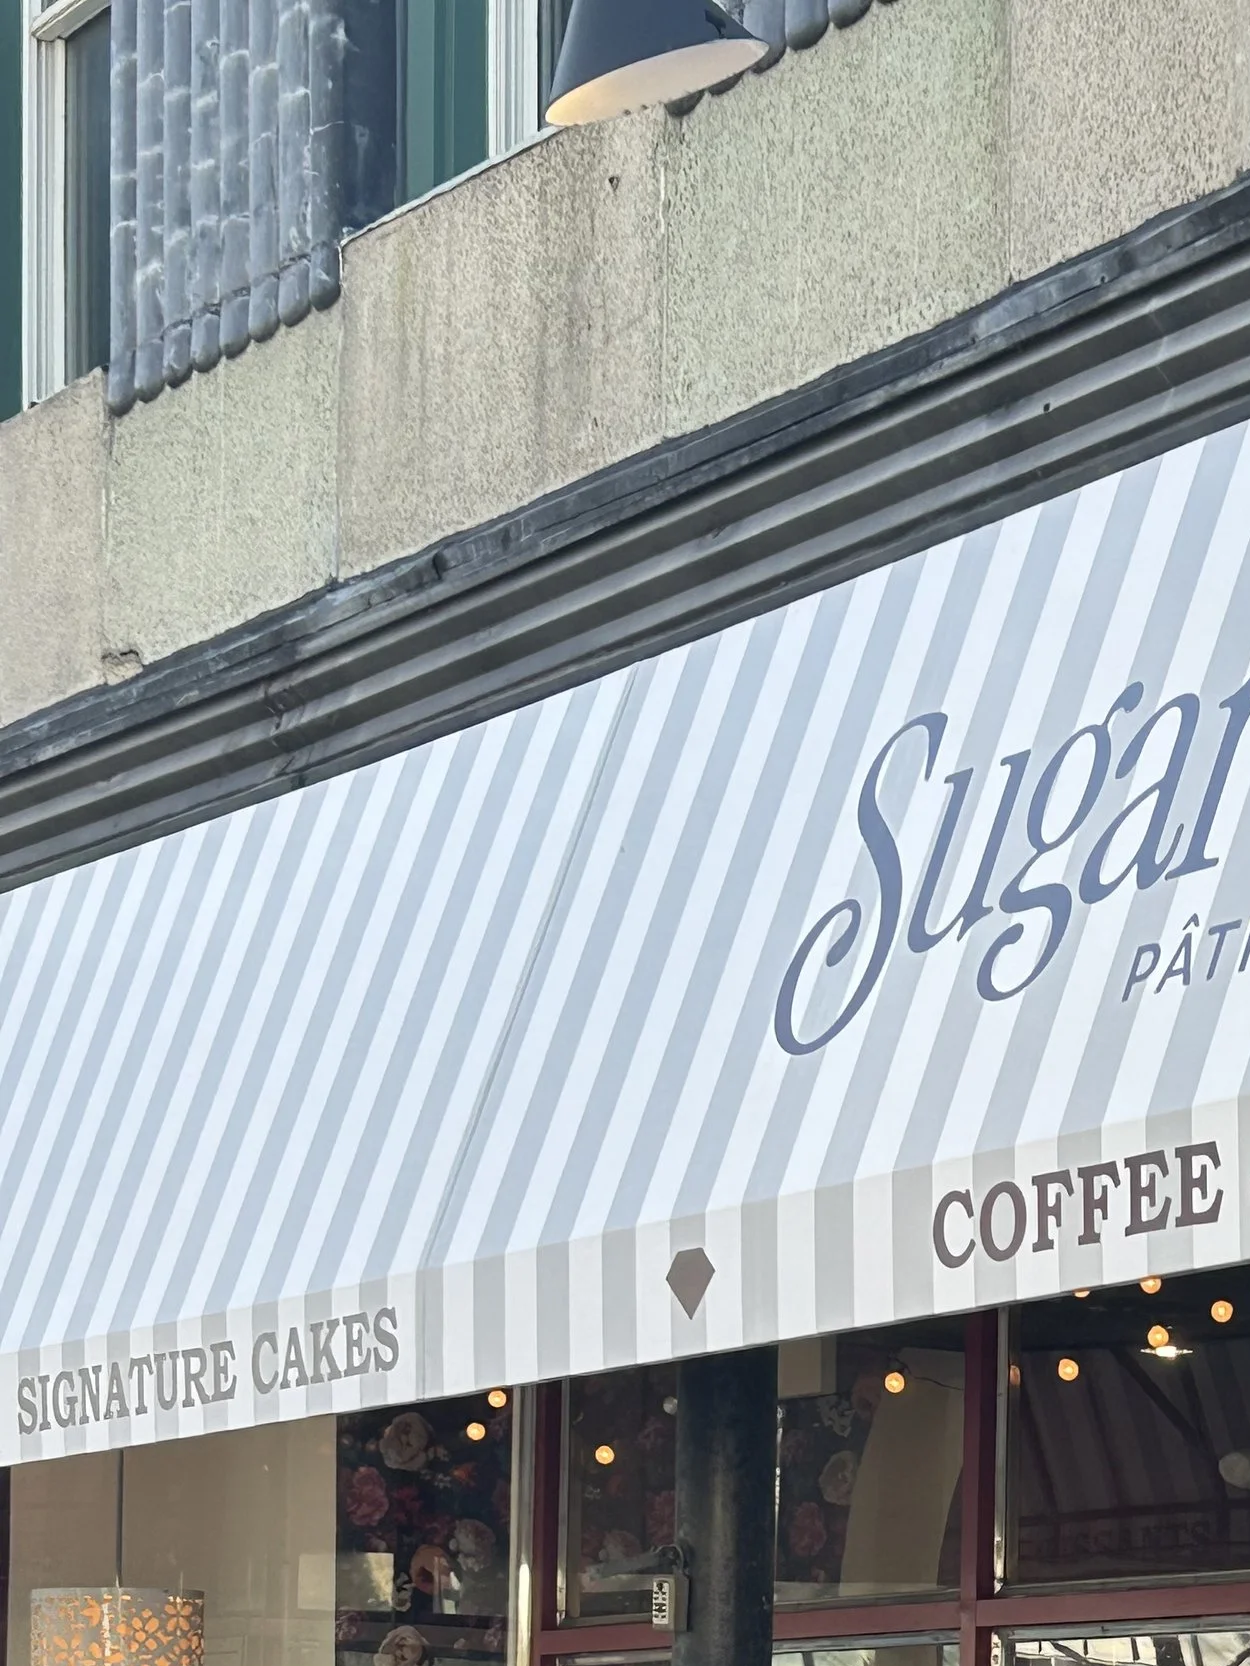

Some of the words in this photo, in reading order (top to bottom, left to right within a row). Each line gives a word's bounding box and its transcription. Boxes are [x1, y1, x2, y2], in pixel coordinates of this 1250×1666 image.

[932, 1140, 1224, 1269] COFFEE
[17, 1340, 237, 1435] SIGNATURE
[251, 1306, 400, 1395] CAKES
